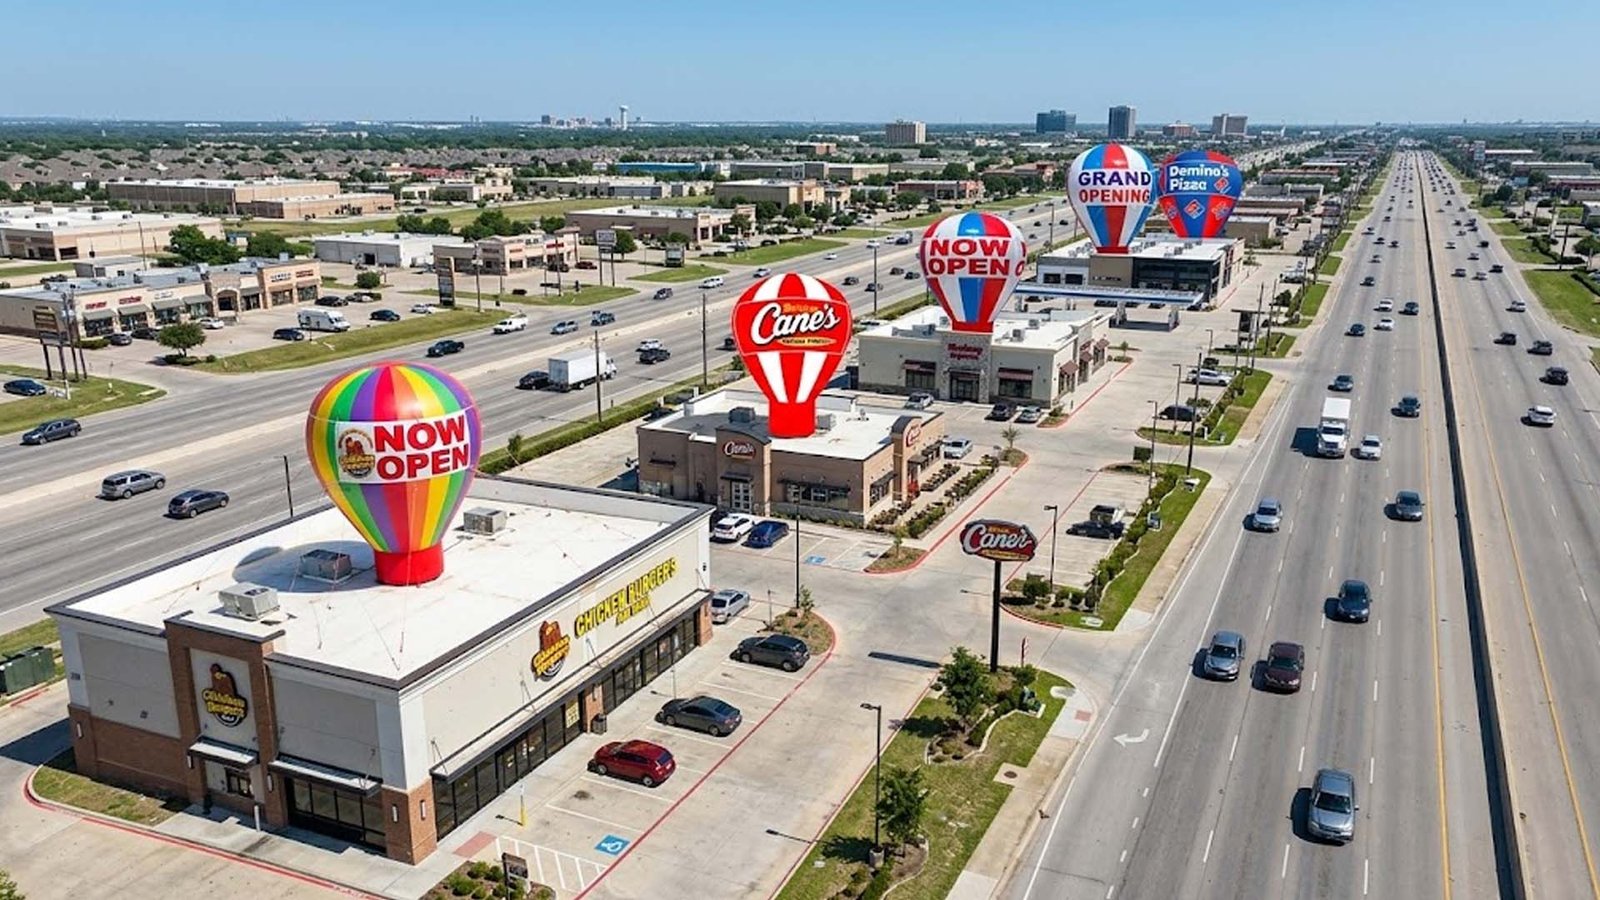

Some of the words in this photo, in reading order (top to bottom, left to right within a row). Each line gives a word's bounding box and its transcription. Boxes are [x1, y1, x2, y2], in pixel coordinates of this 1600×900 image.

[1078, 171, 1151, 186] GRAND
[1169, 178, 1207, 191] Pizza
[1079, 189, 1150, 203] OPENING
[930, 239, 1010, 256] NOW
[928, 258, 1010, 275] OPEN
[750, 302, 840, 345] Cane's
[374, 415, 465, 452] NOW
[376, 444, 469, 480] OPEN
